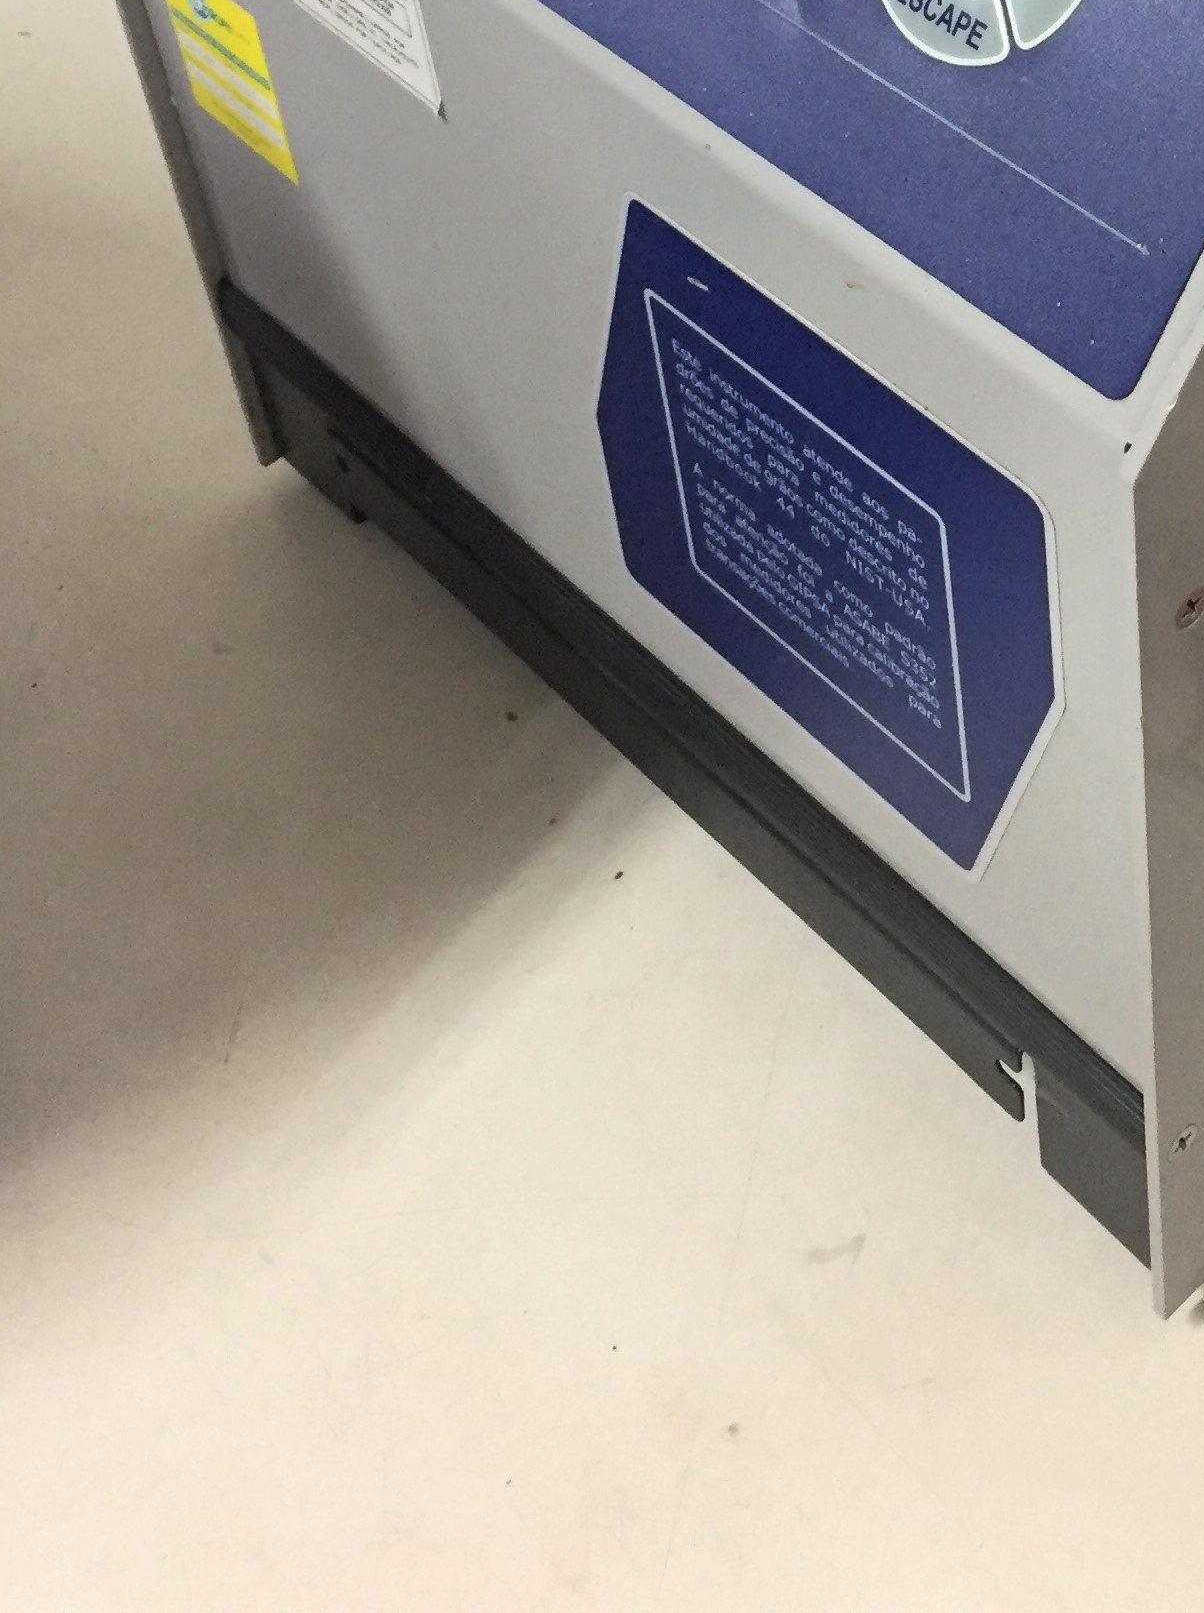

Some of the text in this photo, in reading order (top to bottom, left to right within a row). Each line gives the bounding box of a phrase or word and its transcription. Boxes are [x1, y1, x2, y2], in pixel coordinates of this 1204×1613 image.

[683, 405, 930, 610] umidade de grãos como descrito no
[686, 422, 761, 491] Handbook
[810, 525, 831, 547] do
[710, 372, 794, 444] instrumento
[802, 445, 853, 492] atende
[862, 492, 889, 520] aos
[720, 398, 738, 419] de
[746, 418, 805, 471] precisão
[811, 471, 821, 485] e
[829, 485, 925, 568] desempenho
[767, 454, 800, 486] para
[814, 491, 893, 561] medidores
[908, 567, 927, 590] de
[693, 462, 703, 476] A
[833, 580, 873, 618] como
[884, 622, 936, 670] padrão
[697, 483, 726, 514] para
[825, 589, 834, 603] a
[740, 553, 812, 619] medidores
[825, 625, 894, 688] utilizados
[908, 695, 942, 729] para
[756, 549, 786, 579] pelo
[833, 614, 865, 646] para
[867, 643, 940, 709] calibração
[778, 601, 850, 668] comerciais
